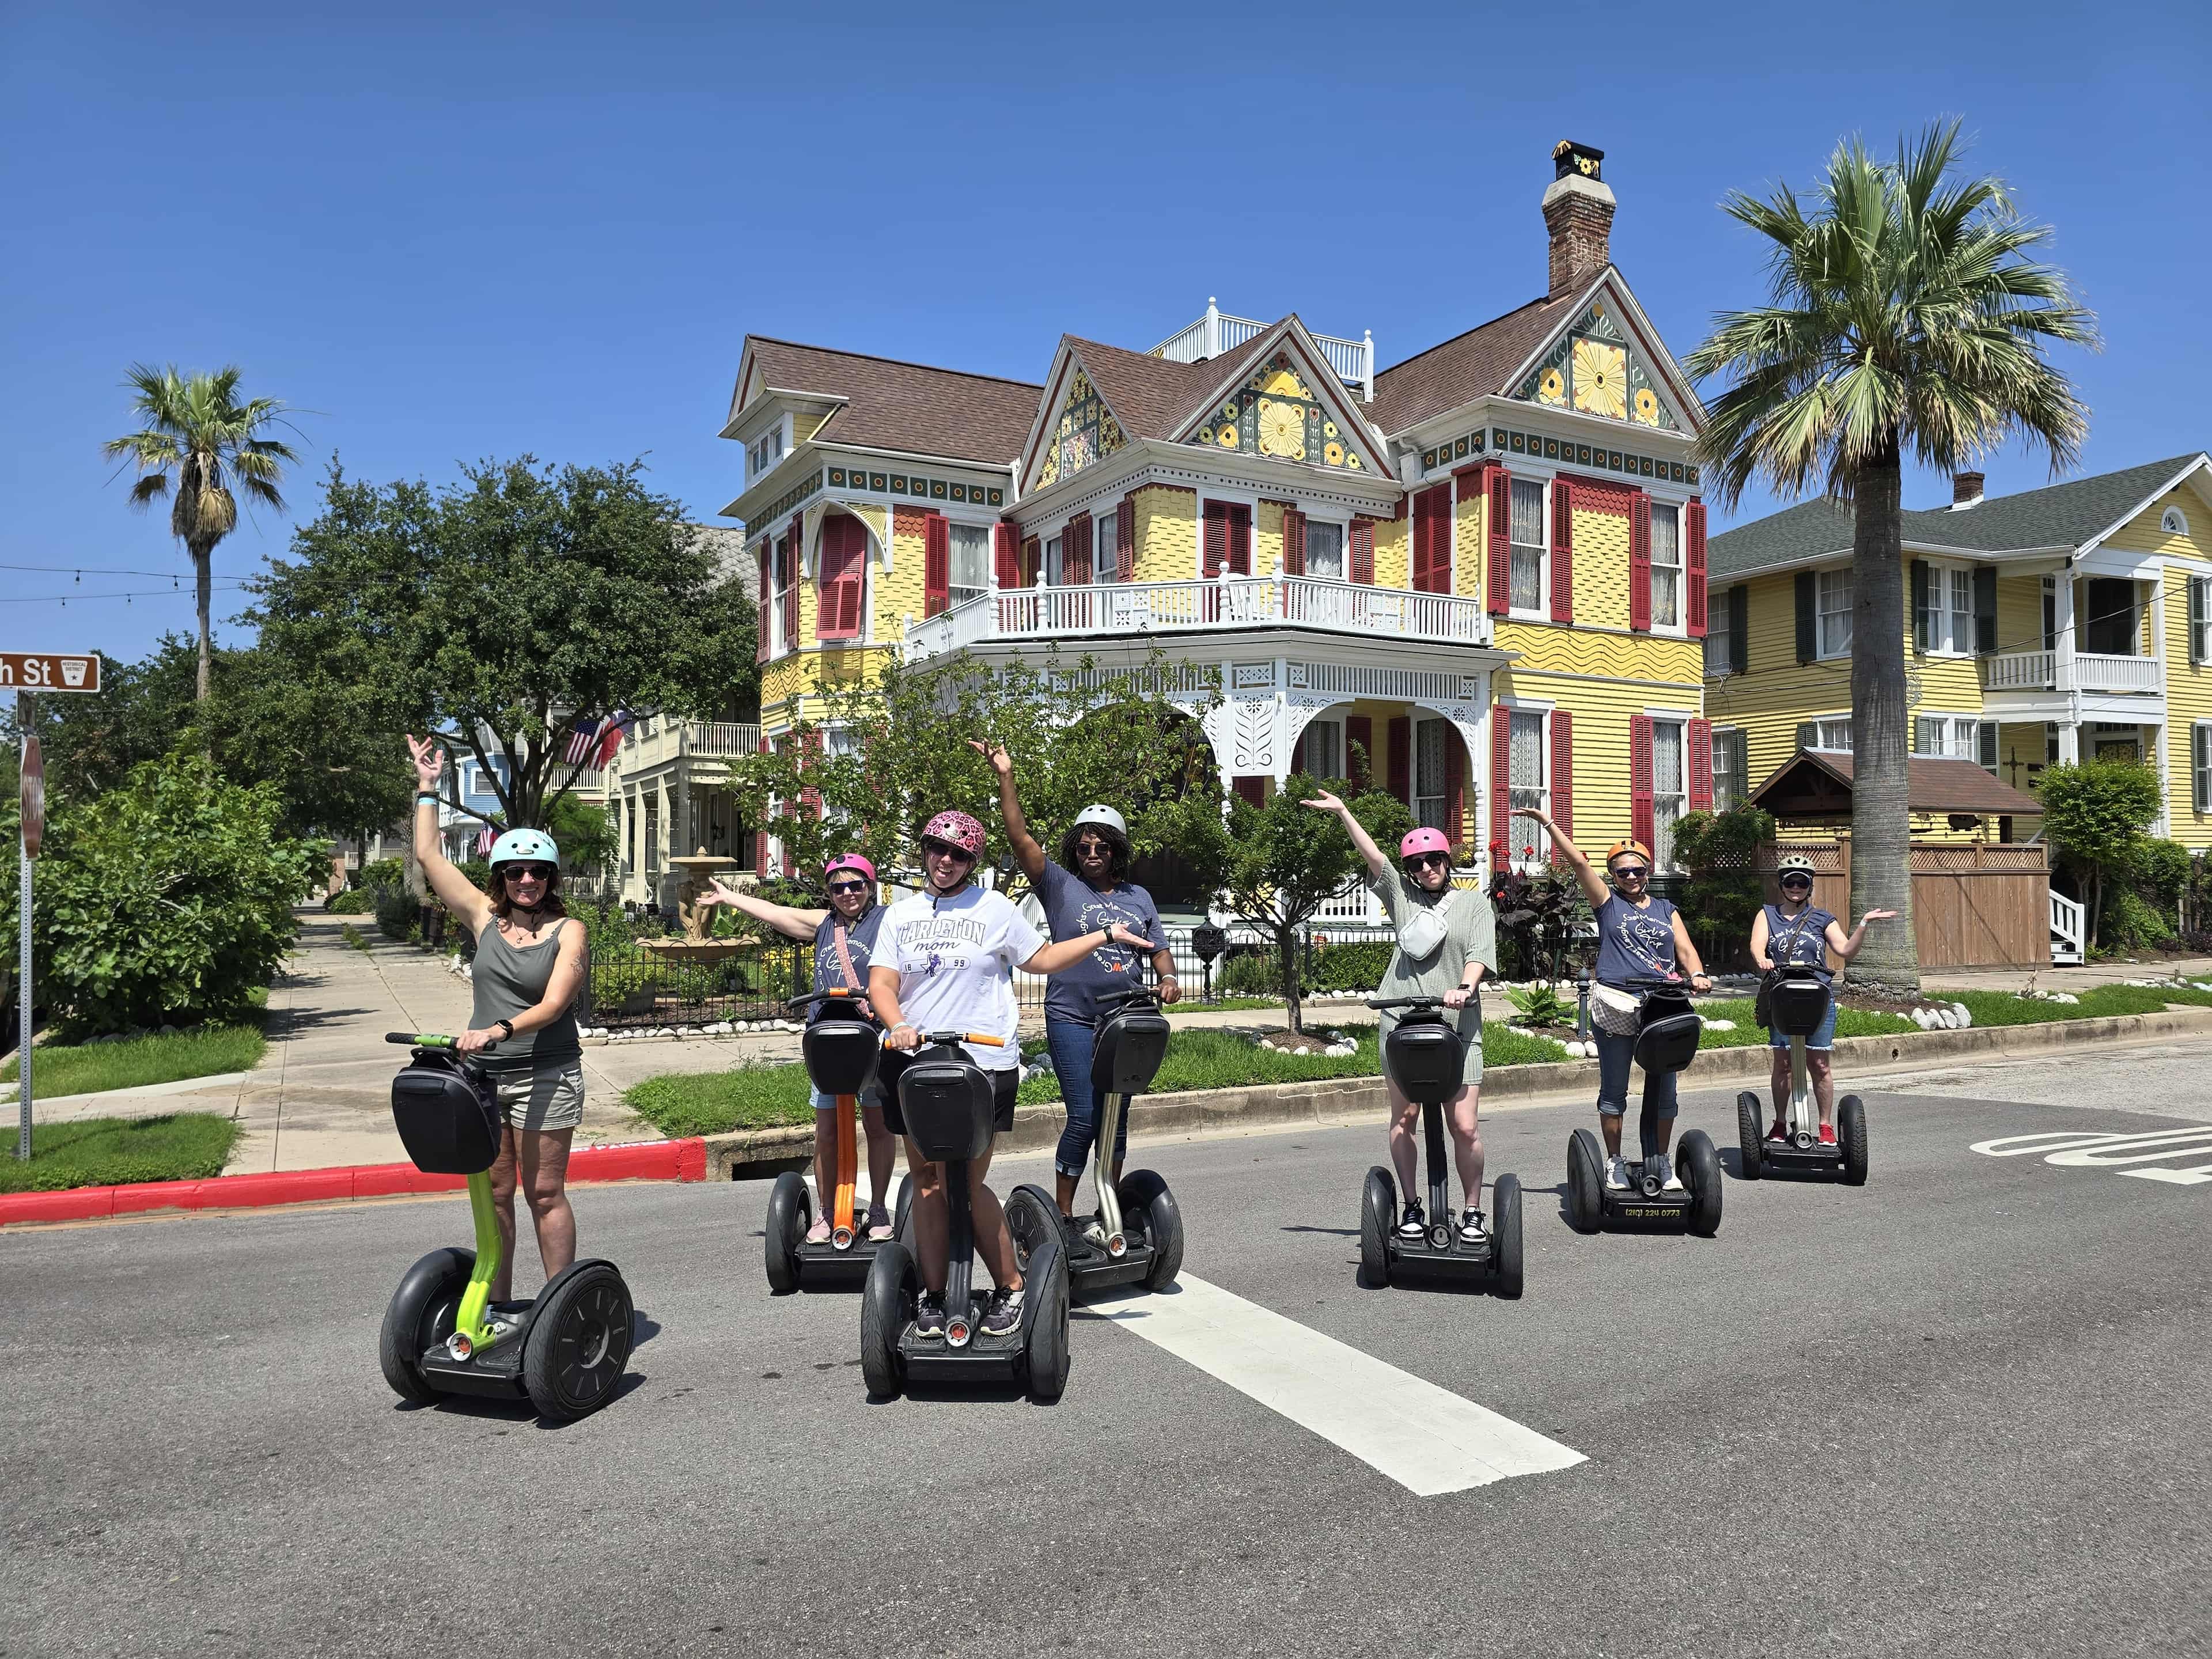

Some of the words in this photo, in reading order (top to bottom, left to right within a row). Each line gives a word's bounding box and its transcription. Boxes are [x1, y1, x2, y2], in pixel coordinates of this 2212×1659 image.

[23, 658, 51, 685] St
[23, 775, 43, 820] STOP
[913, 941, 961, 953] mom
[954, 959, 965, 967] 99
[1645, 1209, 1660, 1217] 224
[1661, 1209, 1680, 1217] 0773
